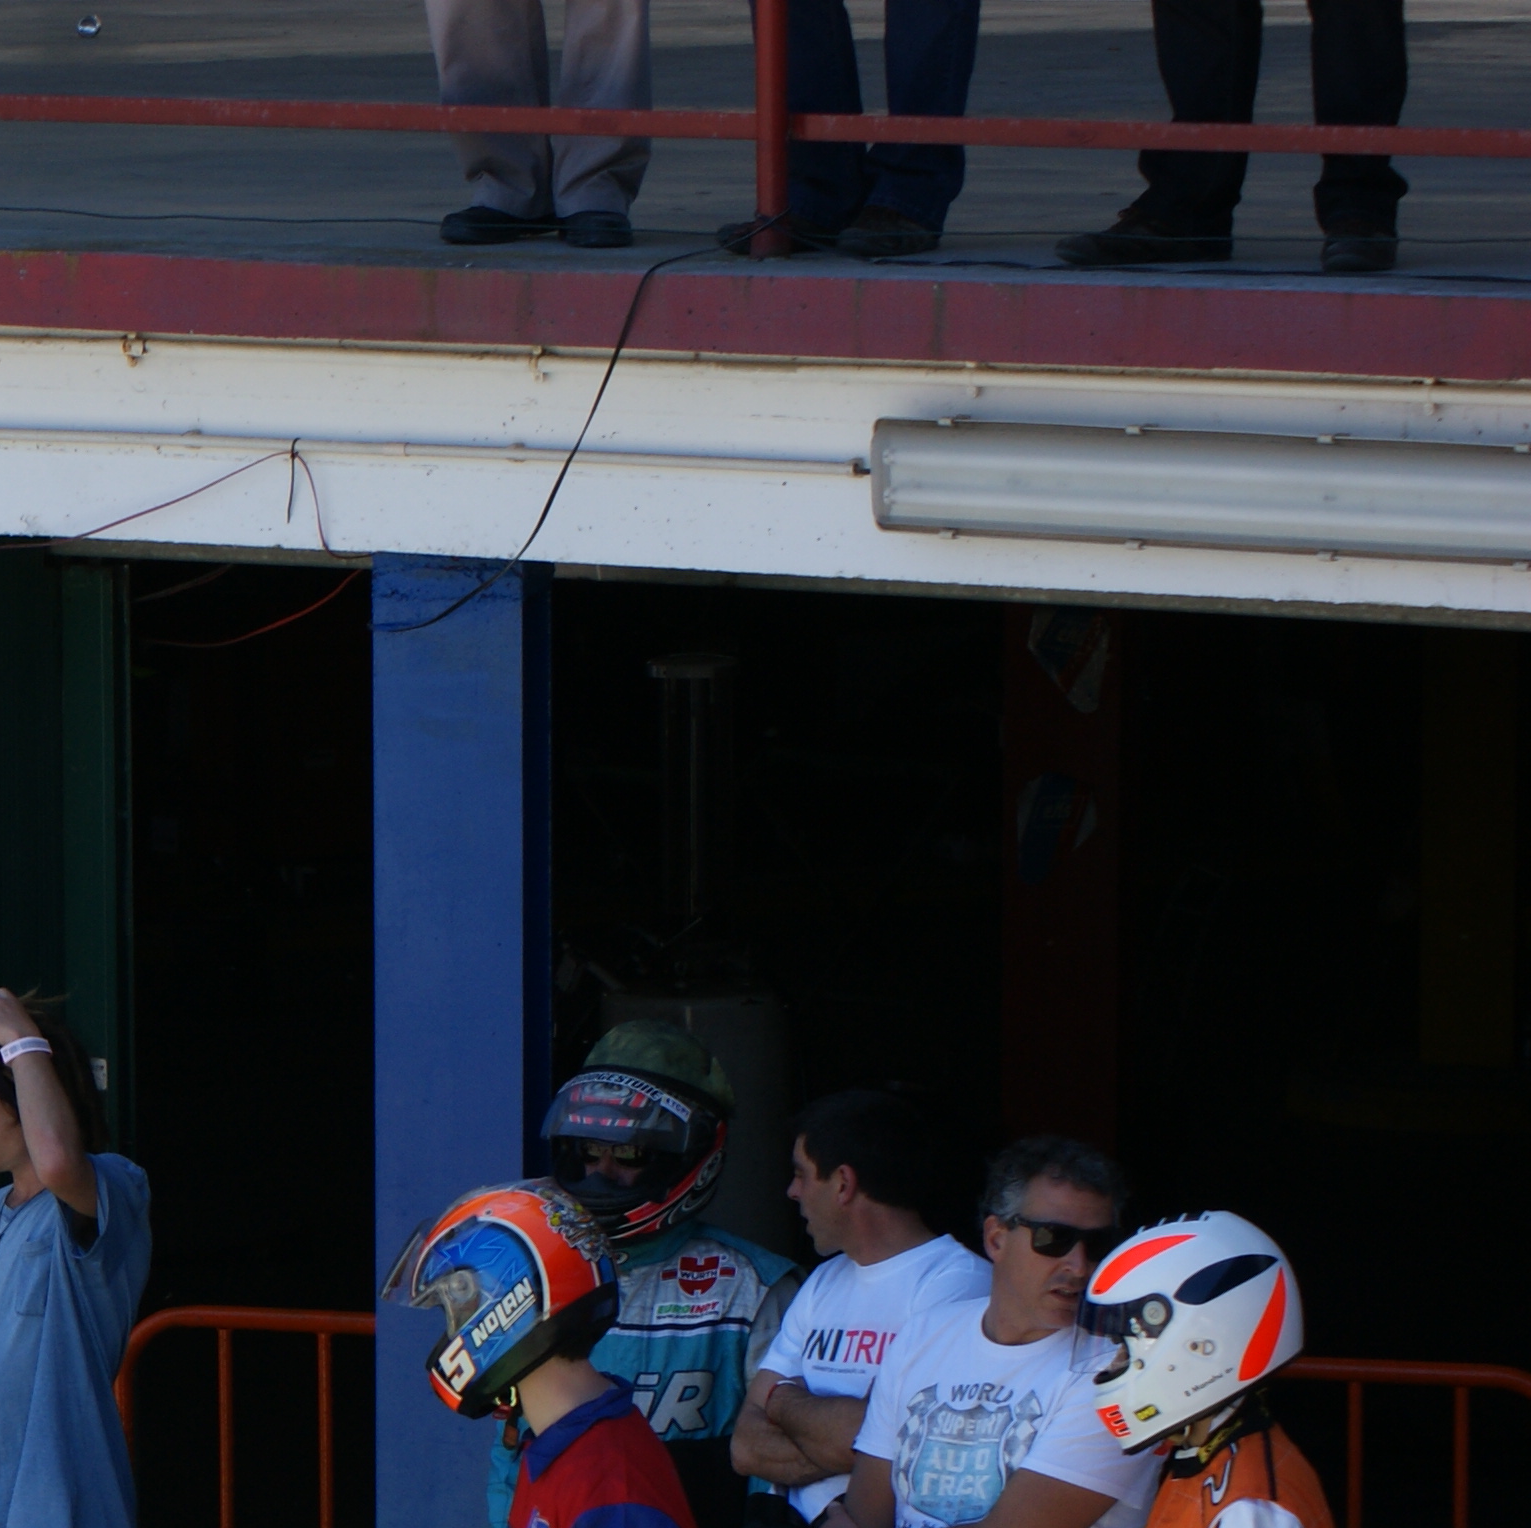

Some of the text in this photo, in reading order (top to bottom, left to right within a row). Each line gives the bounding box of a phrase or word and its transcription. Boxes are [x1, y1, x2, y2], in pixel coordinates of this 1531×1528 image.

[469, 1275, 537, 1349] NOLAN
[656, 1300, 720, 1315] EUROINDY
[437, 1335, 477, 1394] 5
[801, 1327, 897, 1366] NITRI
